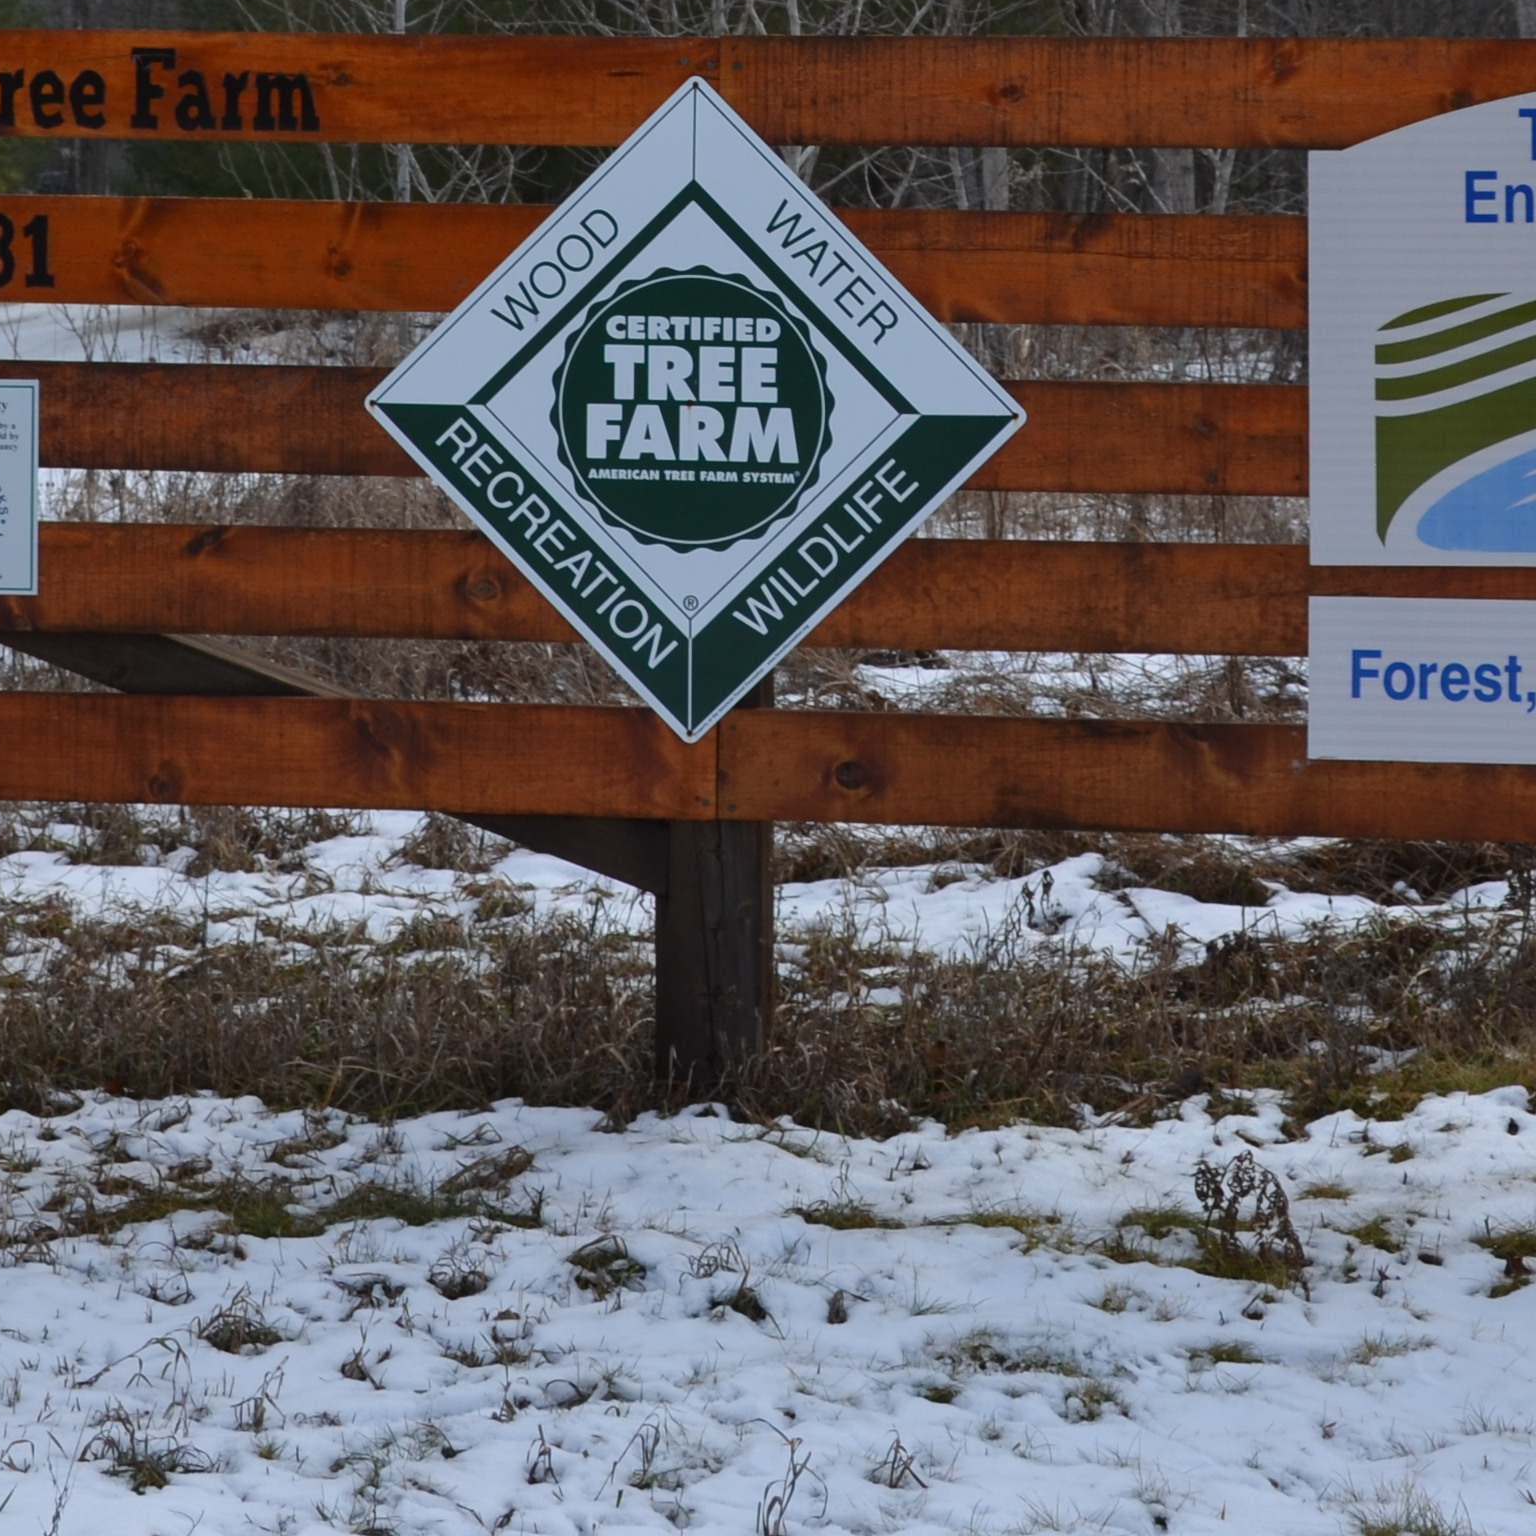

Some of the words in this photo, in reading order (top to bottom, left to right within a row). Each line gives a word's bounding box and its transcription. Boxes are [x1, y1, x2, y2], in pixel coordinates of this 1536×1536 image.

[129, 46, 322, 133] Farm
[490, 209, 619, 331] WOOD
[766, 198, 899, 346] WATER
[605, 315, 781, 343] CERTIFIED
[603, 344, 778, 404] TREE
[586, 403, 800, 464] FARM
[588, 468, 660, 481] AMERICAN
[664, 470, 695, 481] TREE
[700, 471, 738, 482] FARM
[435, 416, 679, 670] RECREATION
[732, 458, 920, 636] WILDLIFE
[1351, 649, 1536, 713] Forest,
